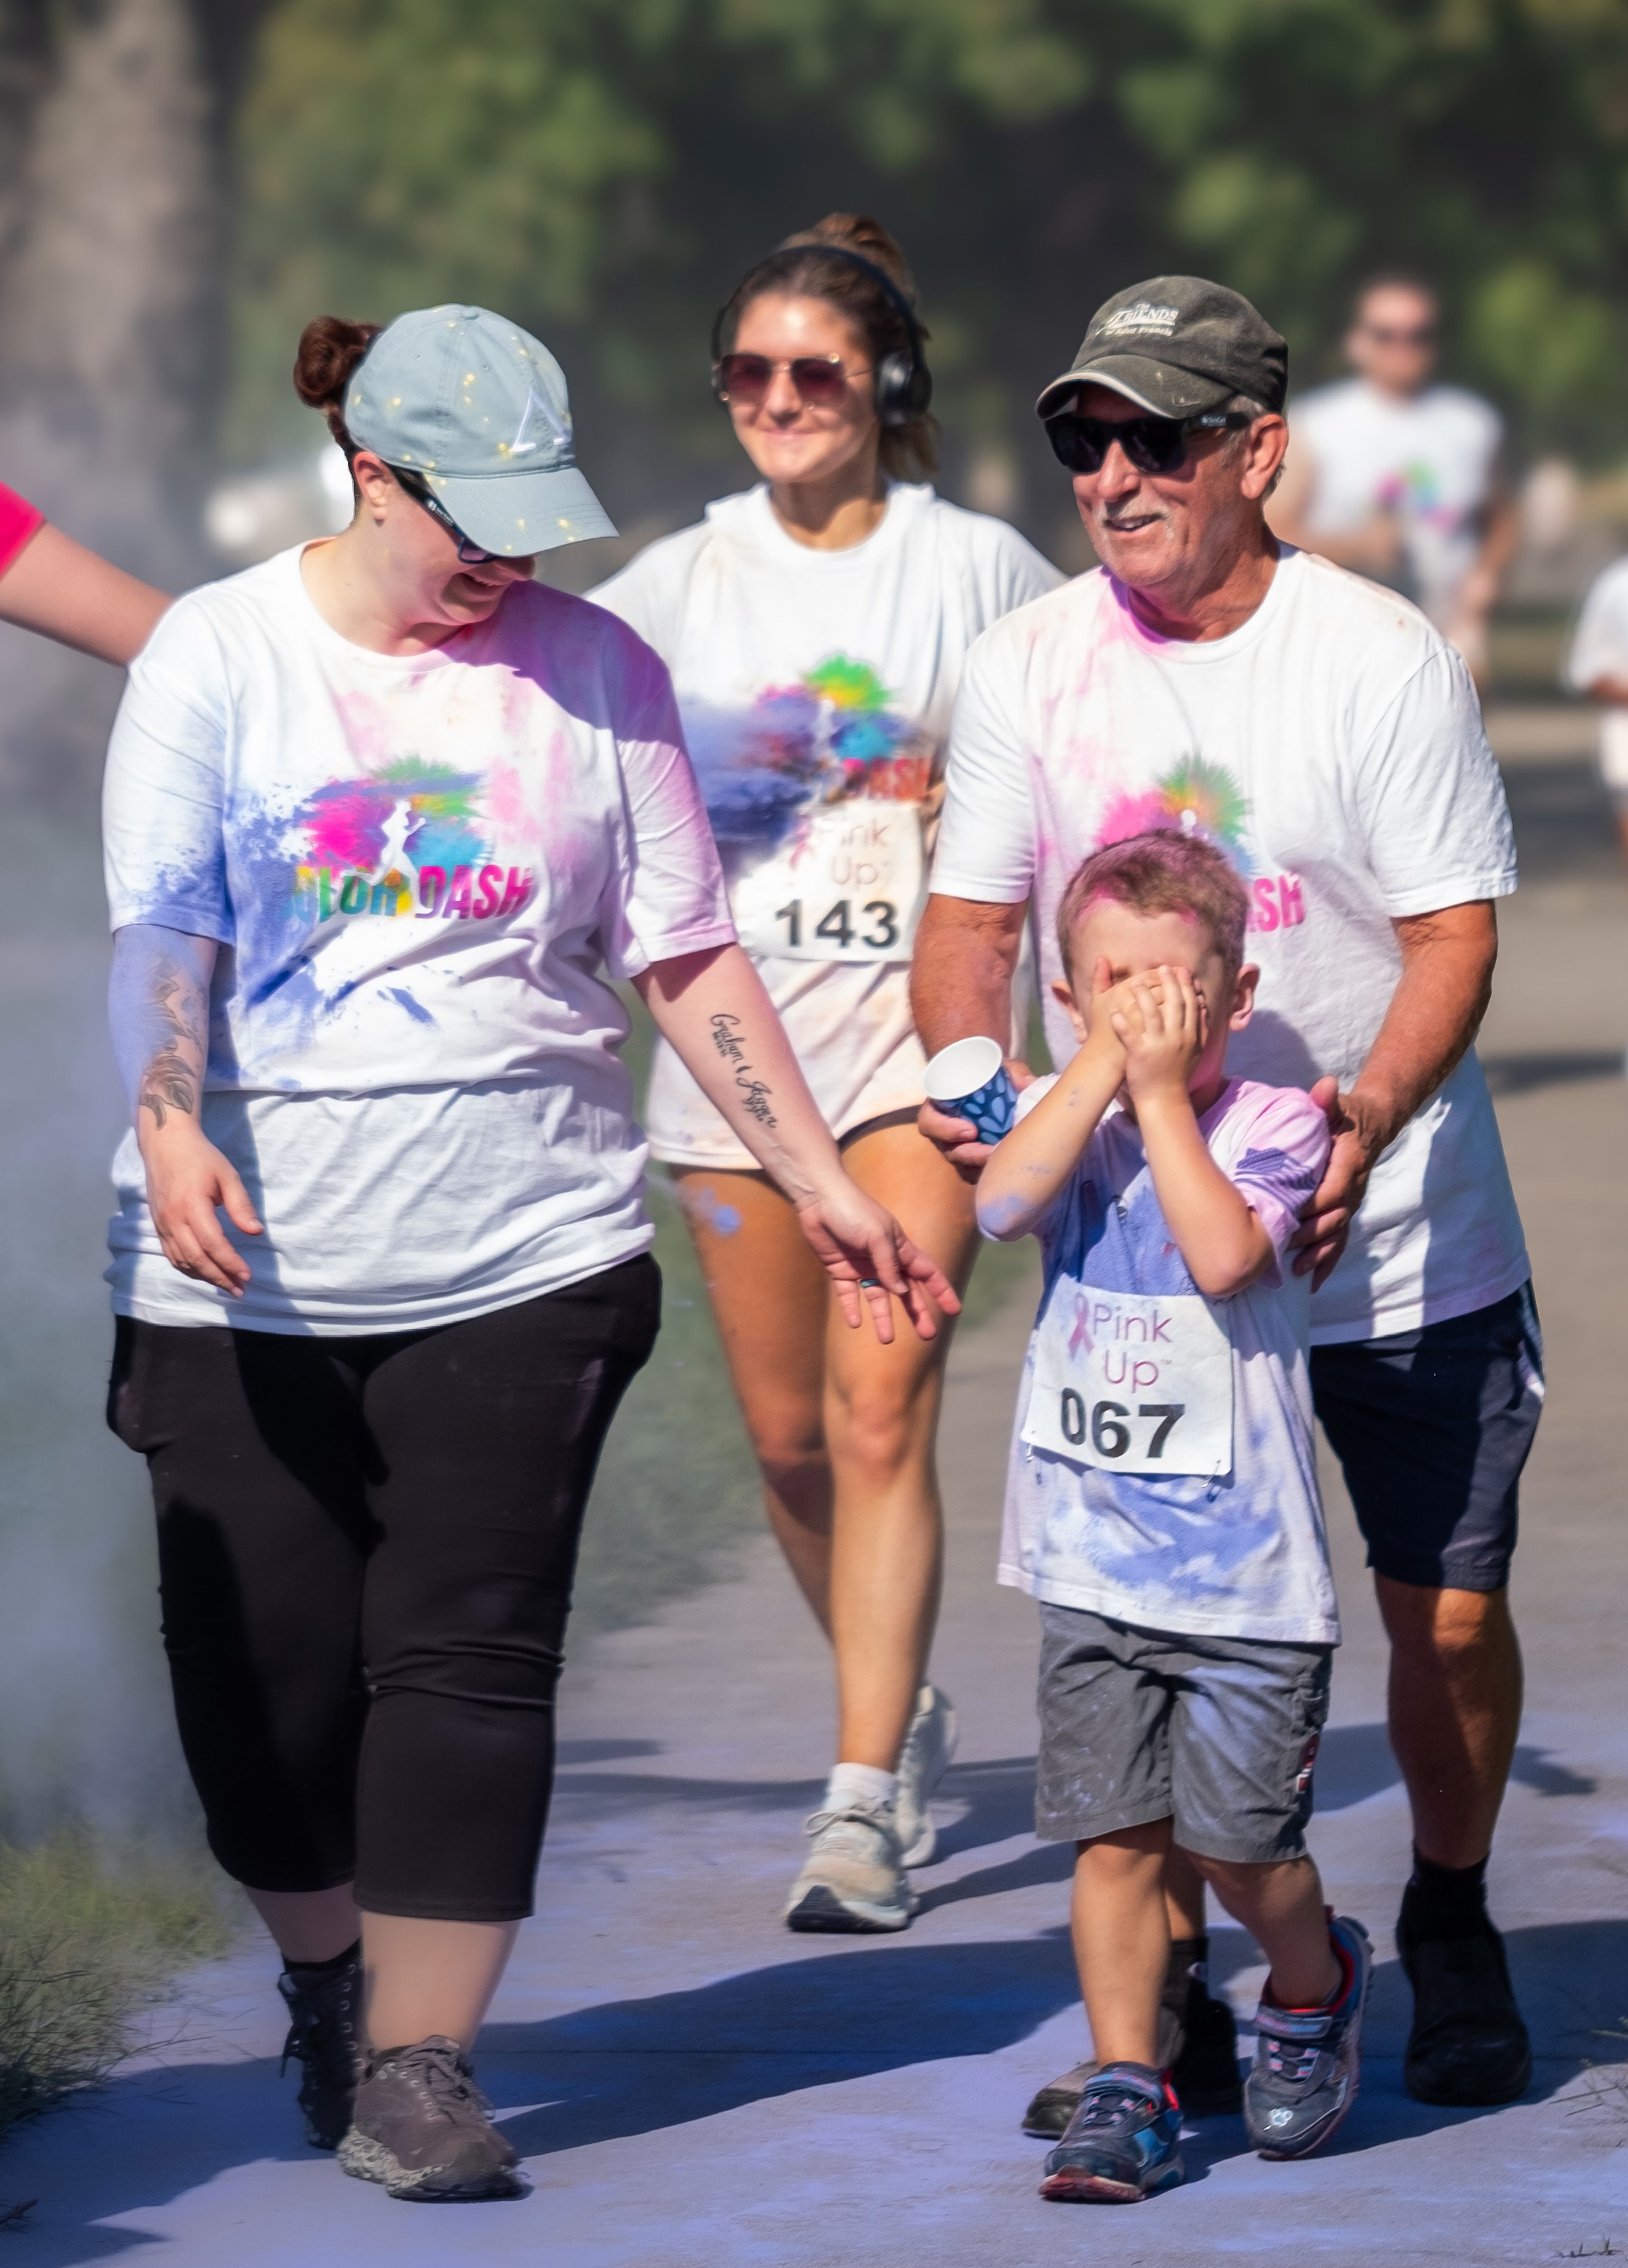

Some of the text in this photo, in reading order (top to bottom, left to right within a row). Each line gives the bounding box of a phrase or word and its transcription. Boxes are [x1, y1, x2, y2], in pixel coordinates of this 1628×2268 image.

[415, 864, 533, 920] DASH
[832, 855, 879, 891] Up
[775, 899, 900, 949] 143
[1093, 1303, 1173, 1343] Pink
[1104, 1349, 1159, 1394] Up
[1061, 1387, 1185, 1459] 067
